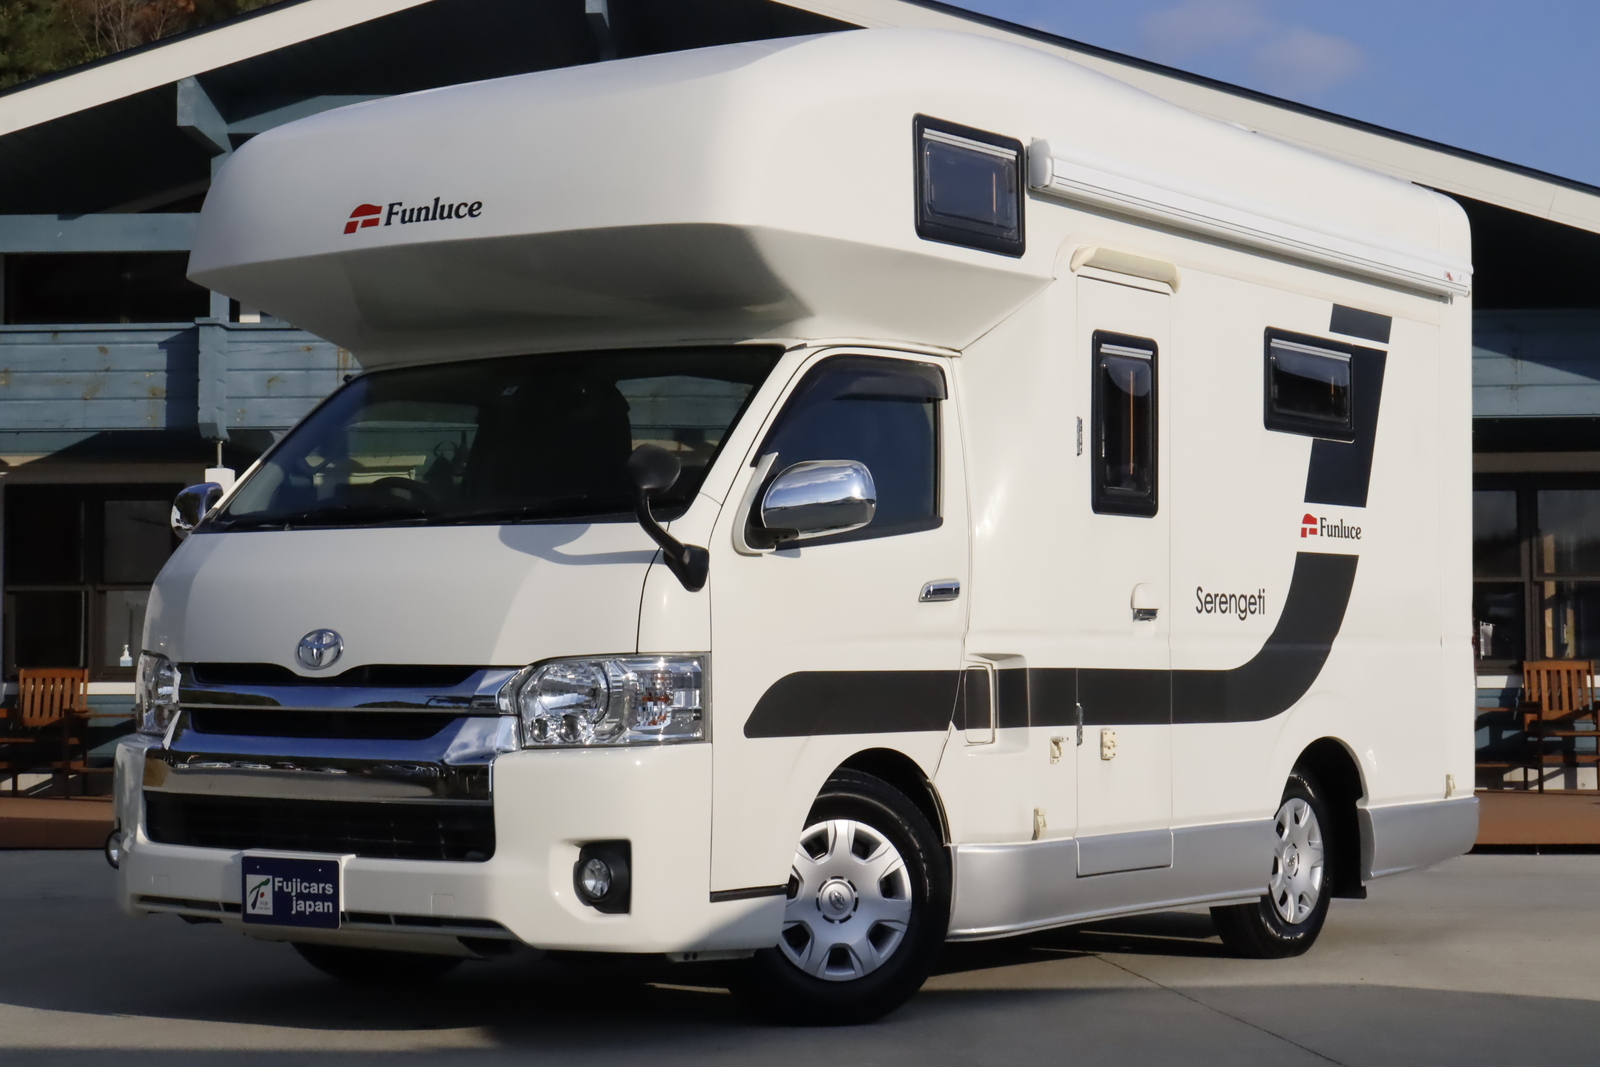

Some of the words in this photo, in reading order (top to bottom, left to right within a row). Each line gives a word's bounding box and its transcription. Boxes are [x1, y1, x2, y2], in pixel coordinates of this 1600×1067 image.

[384, 196, 482, 226] Funluce
[1319, 517, 1362, 540] Funluce
[1195, 586, 1265, 621] Serengeti
[274, 877, 334, 896] Fujicars
[291, 896, 333, 915] japan
